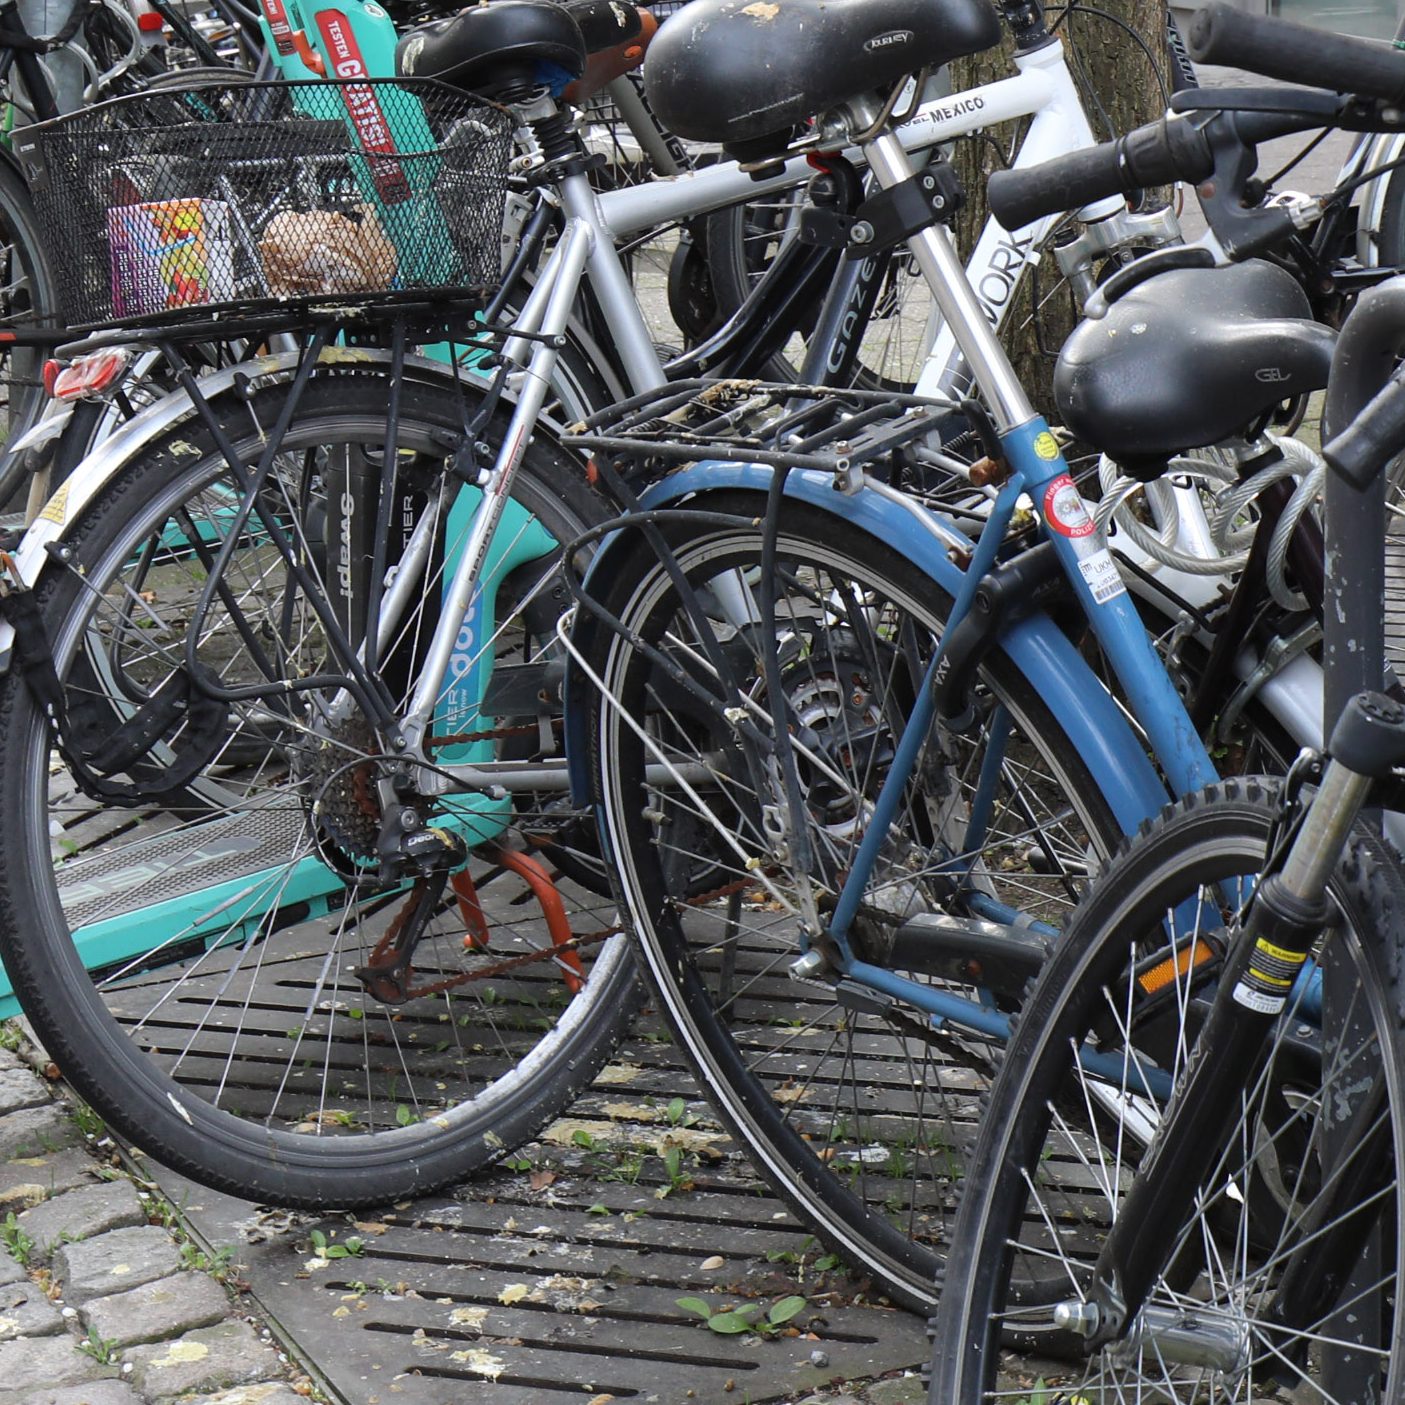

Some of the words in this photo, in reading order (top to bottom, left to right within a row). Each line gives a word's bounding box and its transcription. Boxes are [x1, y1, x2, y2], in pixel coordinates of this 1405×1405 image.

[328, 20, 351, 60] TESTEN
[930, 96, 985, 125] MEXICO
[825, 252, 881, 377] GAZE
[1255, 368, 1291, 383] GEL
[340, 491, 355, 599] Swap!
[402, 494, 414, 549] TIER
[467, 524, 494, 584] SPORT
[933, 654, 952, 686] AXA
[445, 687, 459, 737] TIER
